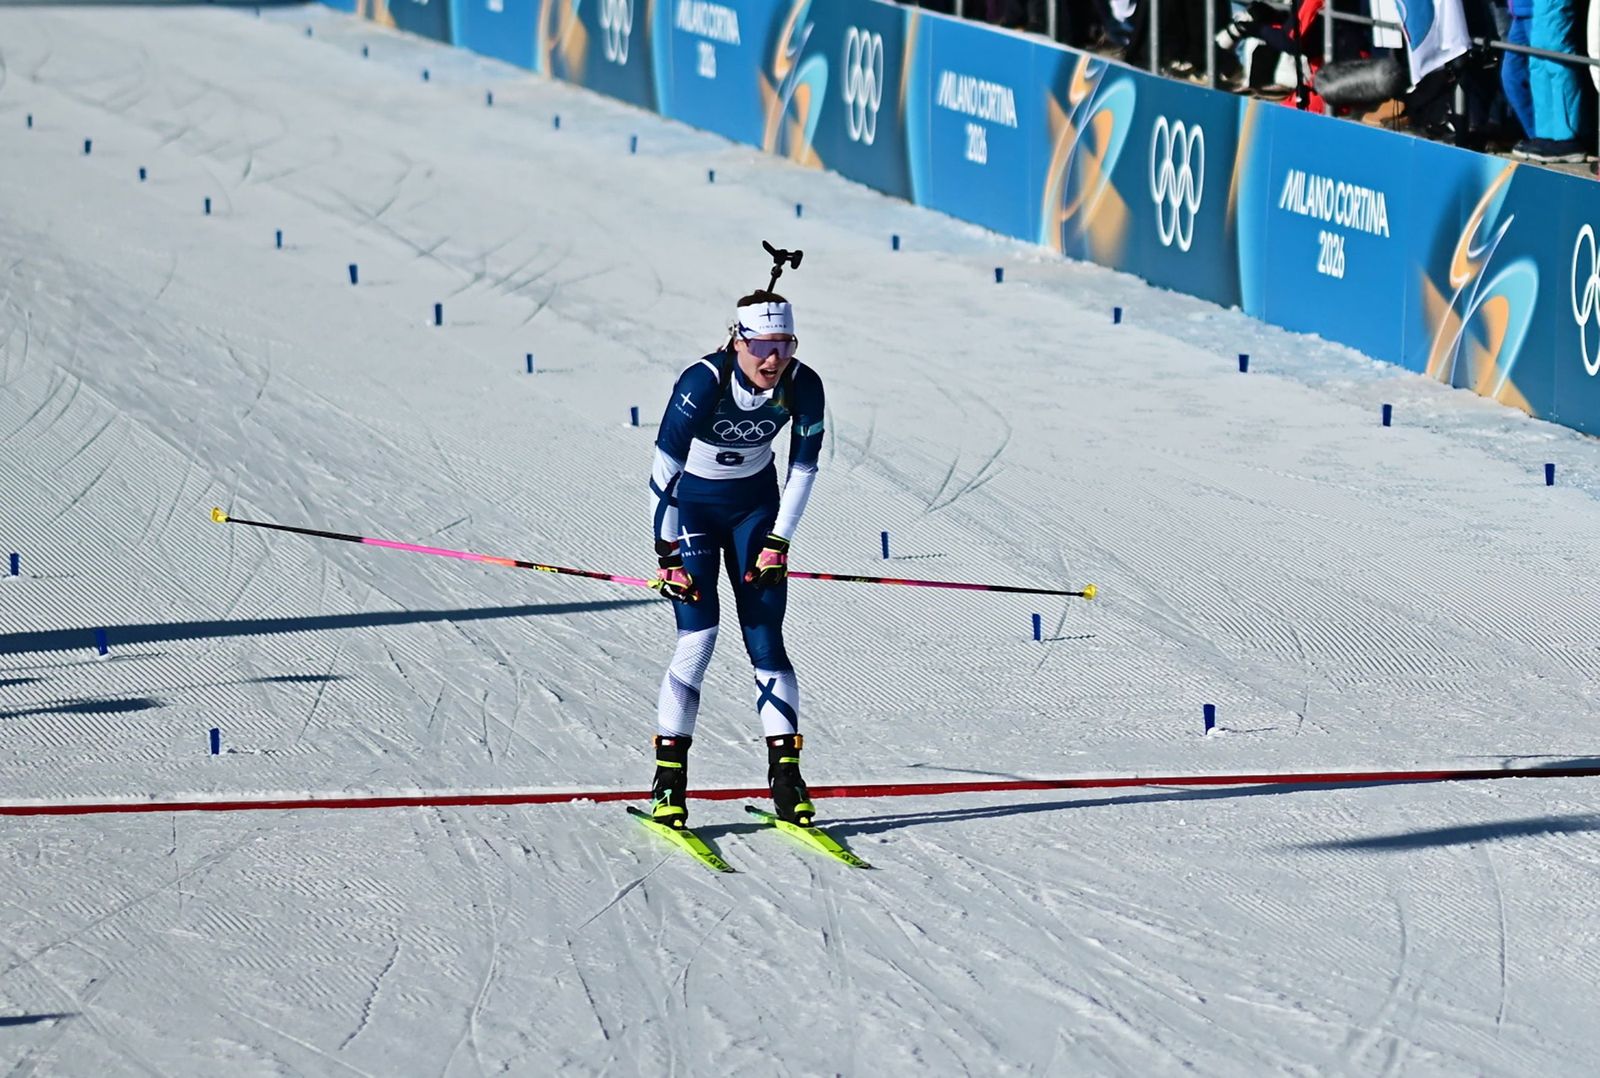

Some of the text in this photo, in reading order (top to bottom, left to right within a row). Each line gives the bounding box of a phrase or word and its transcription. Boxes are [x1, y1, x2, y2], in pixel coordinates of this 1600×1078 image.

[938, 70, 1018, 128] MILANO CORTINA
[1279, 168, 1390, 238] MILANO CORTINA
[1317, 230, 1345, 279] 2026
